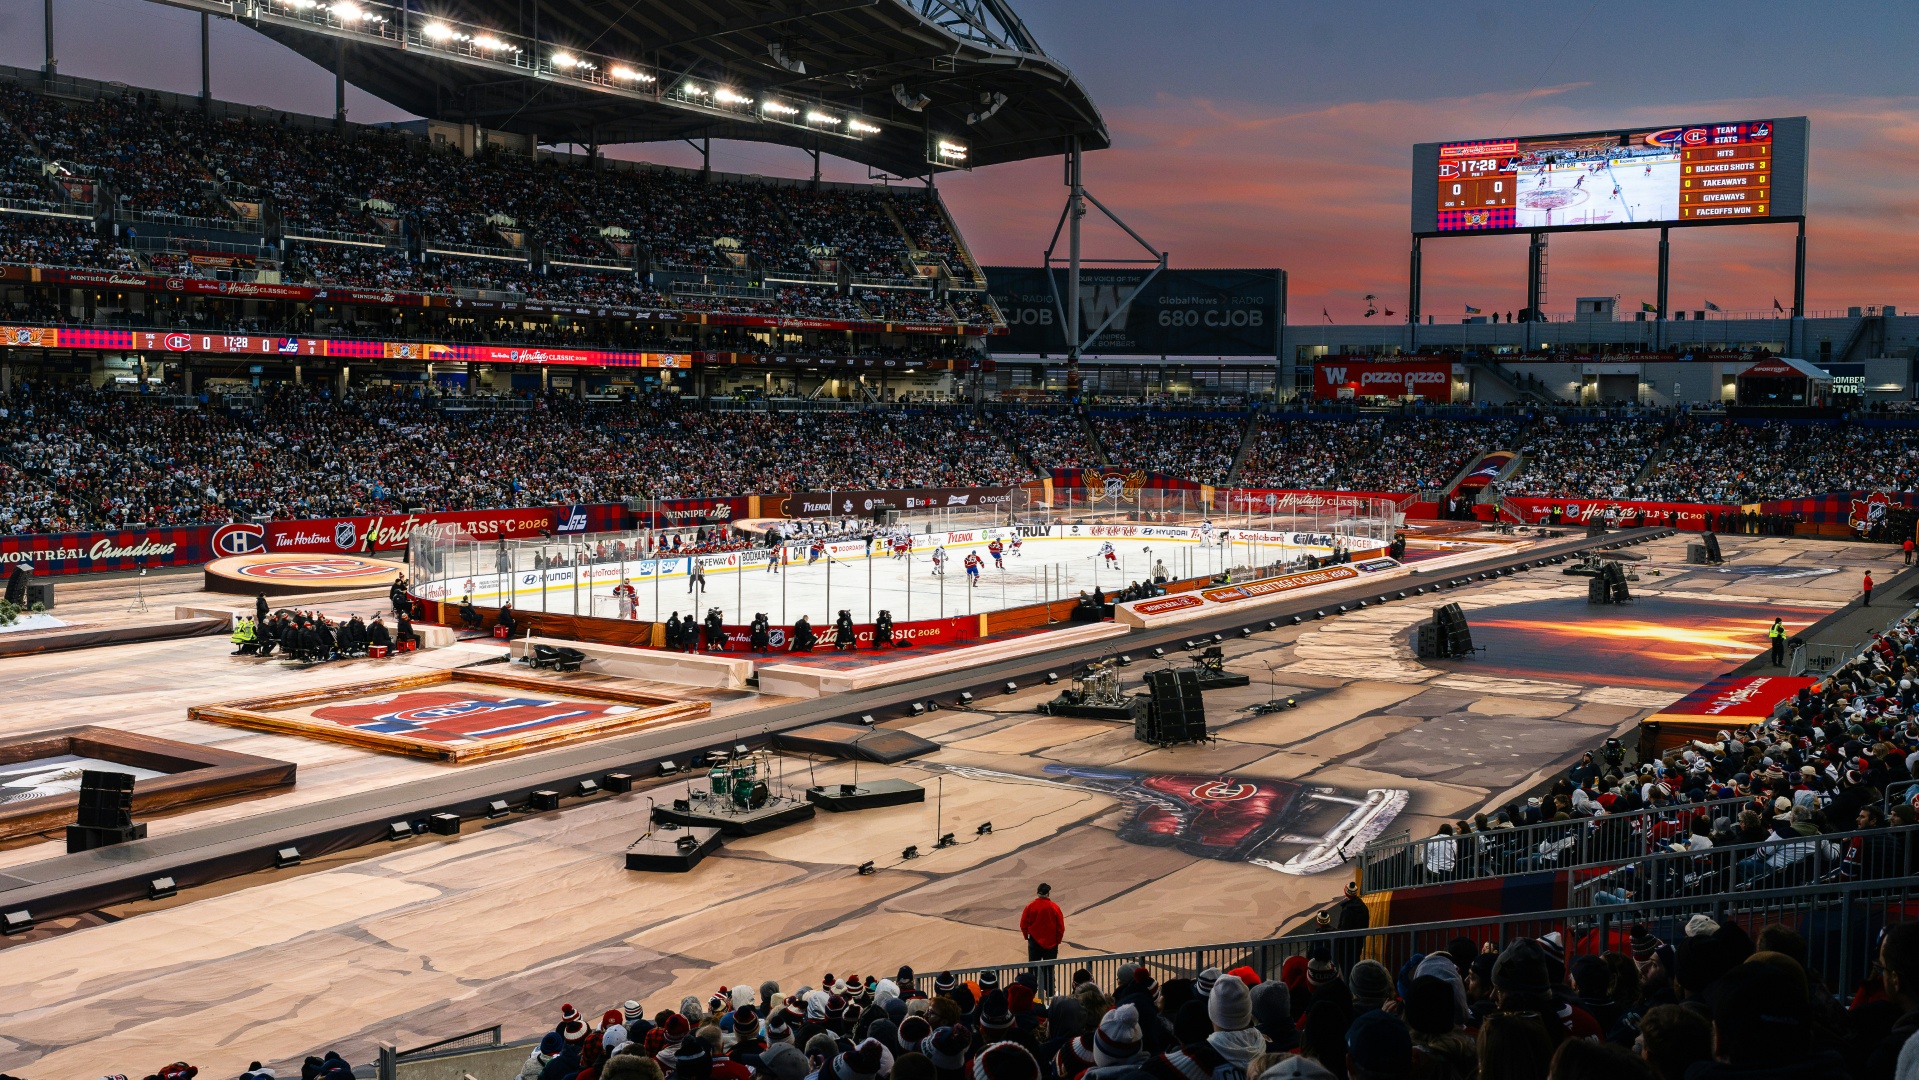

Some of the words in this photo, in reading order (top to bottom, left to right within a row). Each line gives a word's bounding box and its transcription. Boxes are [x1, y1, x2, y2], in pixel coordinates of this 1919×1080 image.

[1717, 126, 1737, 134] TEAM
[1714, 136, 1738, 144] STATS
[1686, 151, 1691, 159] 1
[1717, 149, 1734, 157] HITS
[1761, 146, 1766, 154] 1
[1461, 159, 1497, 173] 17:28
[1685, 166, 1692, 174] 0
[1696, 164, 1729, 173] BLOCKED
[1730, 162, 1754, 171] SHOTS
[1759, 161, 1766, 169] 3
[1685, 180, 1691, 188] 0
[1702, 178, 1747, 187] TAKEAWAYS
[1759, 175, 1766, 183] 0
[1453, 184, 1461, 196] 0
[1494, 181, 1503, 194] 0
[1703, 193, 1745, 202] GIVEAWAYS
[1760, 190, 1764, 198] 1
[1696, 207, 1733, 216] FACEOFFS
[1733, 206, 1751, 214] WON
[1758, 205, 1765, 213] 3
[70, 274, 108, 283] MONTRÉAL
[109, 274, 147, 286] Canadiens
[227, 282, 259, 296] Heritage
[1022, 294, 1054, 303] RADIO
[1231, 296, 1264, 305] RADIO
[1158, 309, 1199, 327] 680
[1203, 309, 1264, 327] CJOB
[148, 341, 153, 349] 2
[203, 337, 211, 350] 0
[224, 336, 248, 348] 17:28
[263, 339, 270, 352] 0
[518, 349, 548, 364] Heritage
[548, 354, 575, 362] CLASSIC
[1070, 346, 1077, 358] 2
[1600, 352, 1632, 363] Heritage
[1738, 352, 1755, 361] Jets
[1375, 354, 1402, 364] Heritage
[1519, 354, 1548, 362] Canadiens
[1325, 367, 1348, 385] W
[1361, 372, 1402, 387] pizza
[1405, 372, 1446, 388] pizza
[1832, 385, 1865, 394] STOR
[915, 498, 937, 508] Expdia
[1279, 492, 1326, 509] Heritage
[1326, 498, 1370, 508] CLASS
[711, 503, 732, 519] Jets
[803, 502, 832, 513] TYLENOL
[360, 513, 443, 554] Heritage
[446, 519, 516, 536] CLASSC
[518, 518, 549, 530] 2026
[1015, 525, 1052, 538] TRULY
[1156, 529, 1189, 537] HYUNDAI
[1238, 531, 1285, 542] Scotiabank
[275, 532, 293, 548] Tim
[294, 531, 331, 546] Hortons
[948, 533, 974, 545] TYLENOL
[1292, 533, 1333, 549] Gillette
[0, 546, 88, 564] MONTRÉAL
[89, 537, 177, 561] Canadiens
[838, 543, 865, 553] DOORDASH
[741, 550, 771, 562] BODYARM
[793, 547, 808, 561] CAT
[640, 562, 656, 571] SAP
[662, 561, 677, 570] SAP
[695, 556, 728, 568] FEWAY
[538, 571, 574, 583] HYUNDAI
[1246, 580, 1296, 595] HERITAGE
[1292, 572, 1329, 587] CLASSIC
[859, 628, 916, 643] CLSIC
[917, 628, 940, 639] 2026
